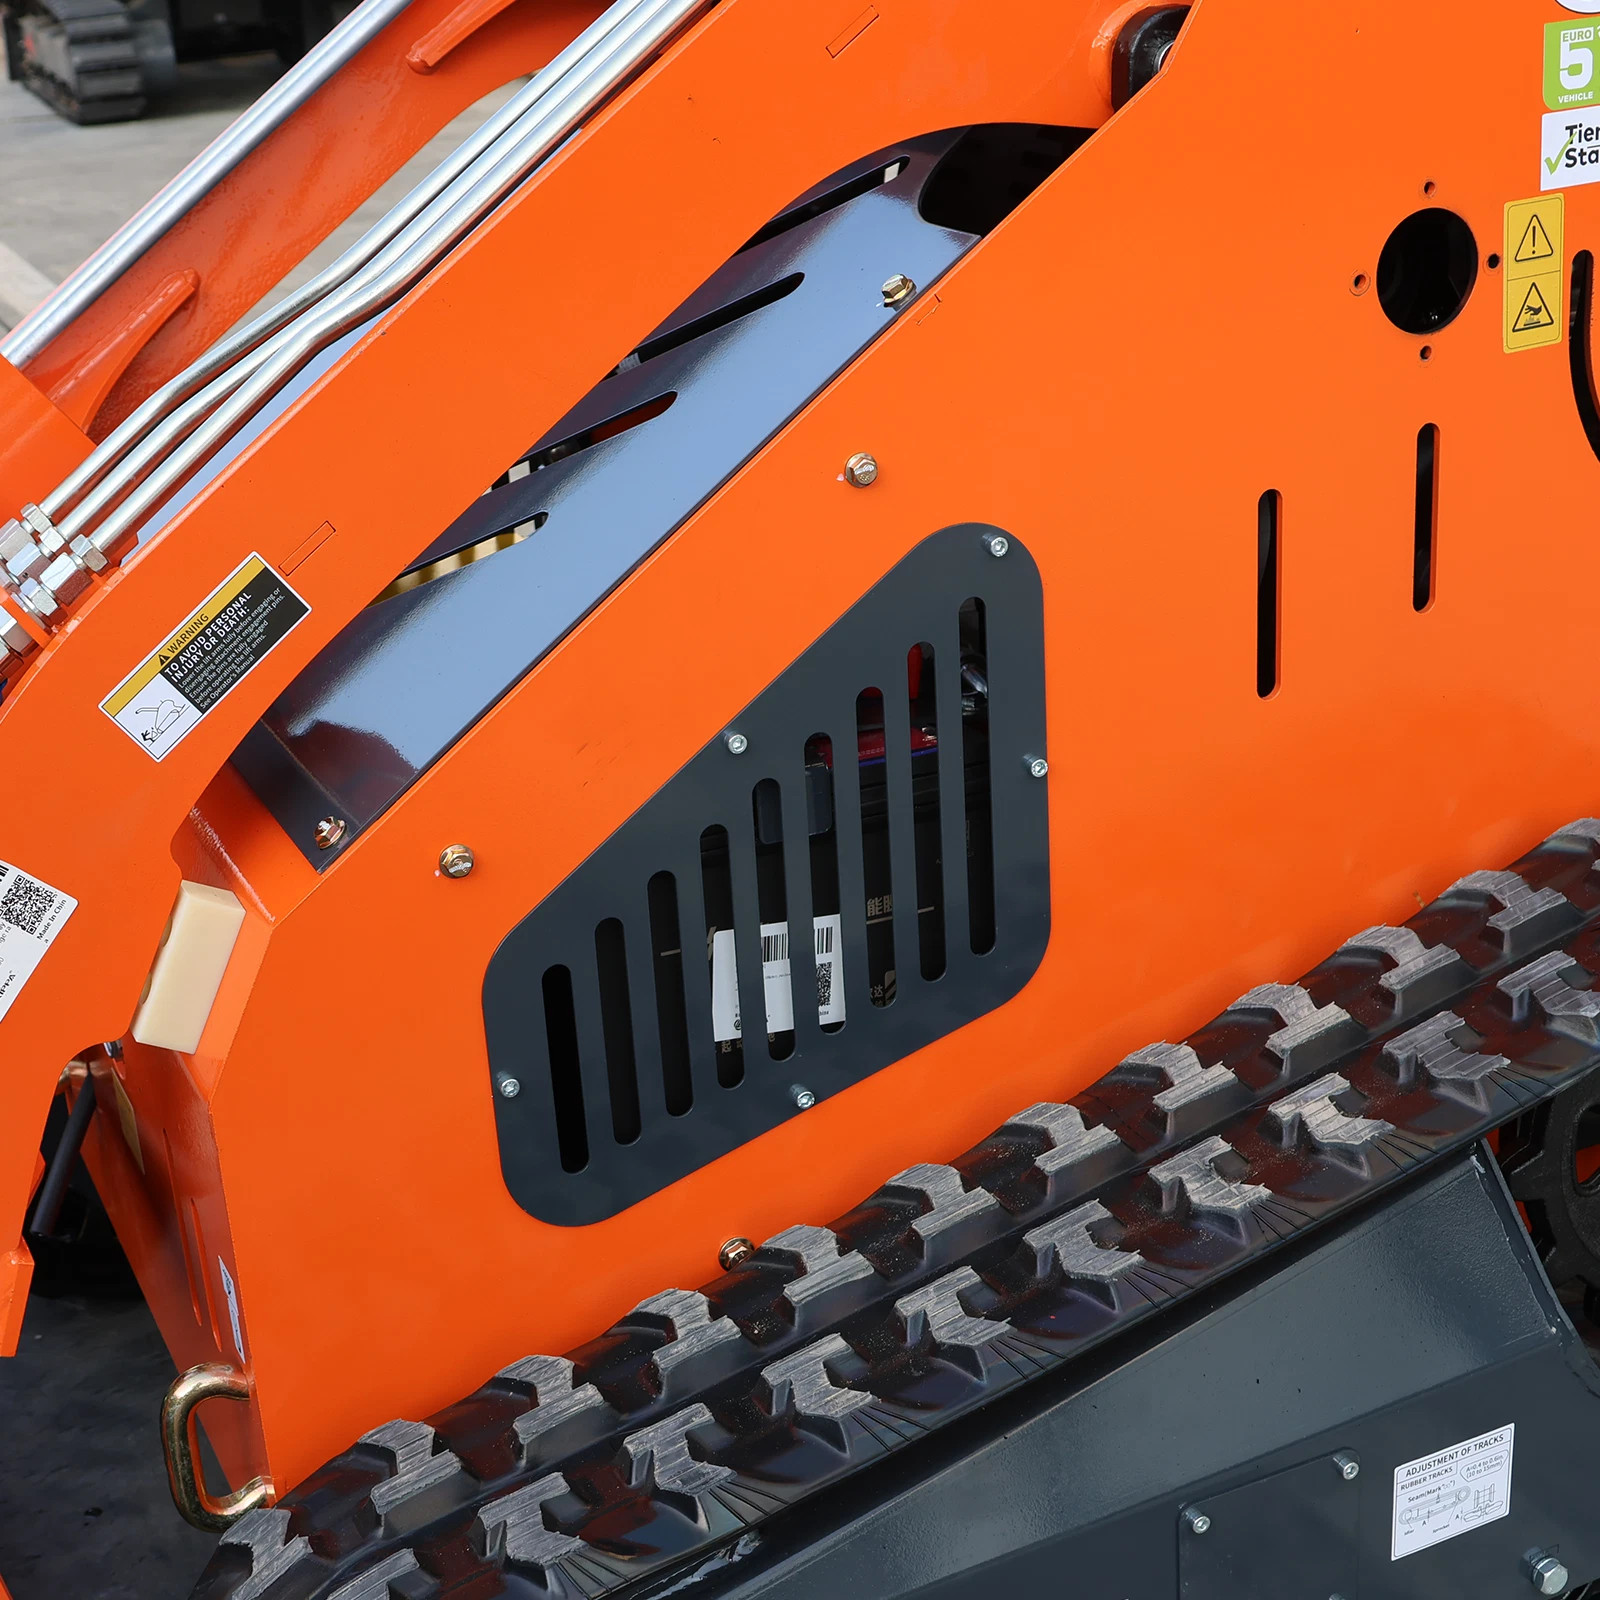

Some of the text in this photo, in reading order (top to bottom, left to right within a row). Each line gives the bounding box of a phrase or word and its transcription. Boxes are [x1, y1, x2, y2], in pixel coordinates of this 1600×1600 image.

[1563, 29, 1592, 42] EURO
[1560, 36, 1594, 90] 5
[1558, 91, 1594, 104] VEHICLE
[1565, 147, 1599, 168] Sta
[165, 592, 252, 675] TO AVOID PERSONAL
[167, 613, 209, 654] WARNING
[171, 606, 250, 683] INJURY OR DEATH:
[178, 587, 281, 689] Lower the lift arms fully before engaging or
[184, 662, 217, 694] disengaging
[214, 635, 243, 665] attachment
[241, 605, 273, 637] engagement
[189, 619, 269, 699] Ensure the pins are fully engaged
[194, 686, 213, 704] before
[211, 663, 238, 688] operating
[234, 654, 245, 665] the
[242, 646, 252, 656] lift
[200, 653, 256, 709] See Operator's Manual
[37, 921, 52, 941] Made
[54, 899, 67, 914] Chin
[1400, 1466, 1453, 1491] RUBBER TRACKS
[1406, 1433, 1504, 1477] ADJUSTMENT OF TRACKS
